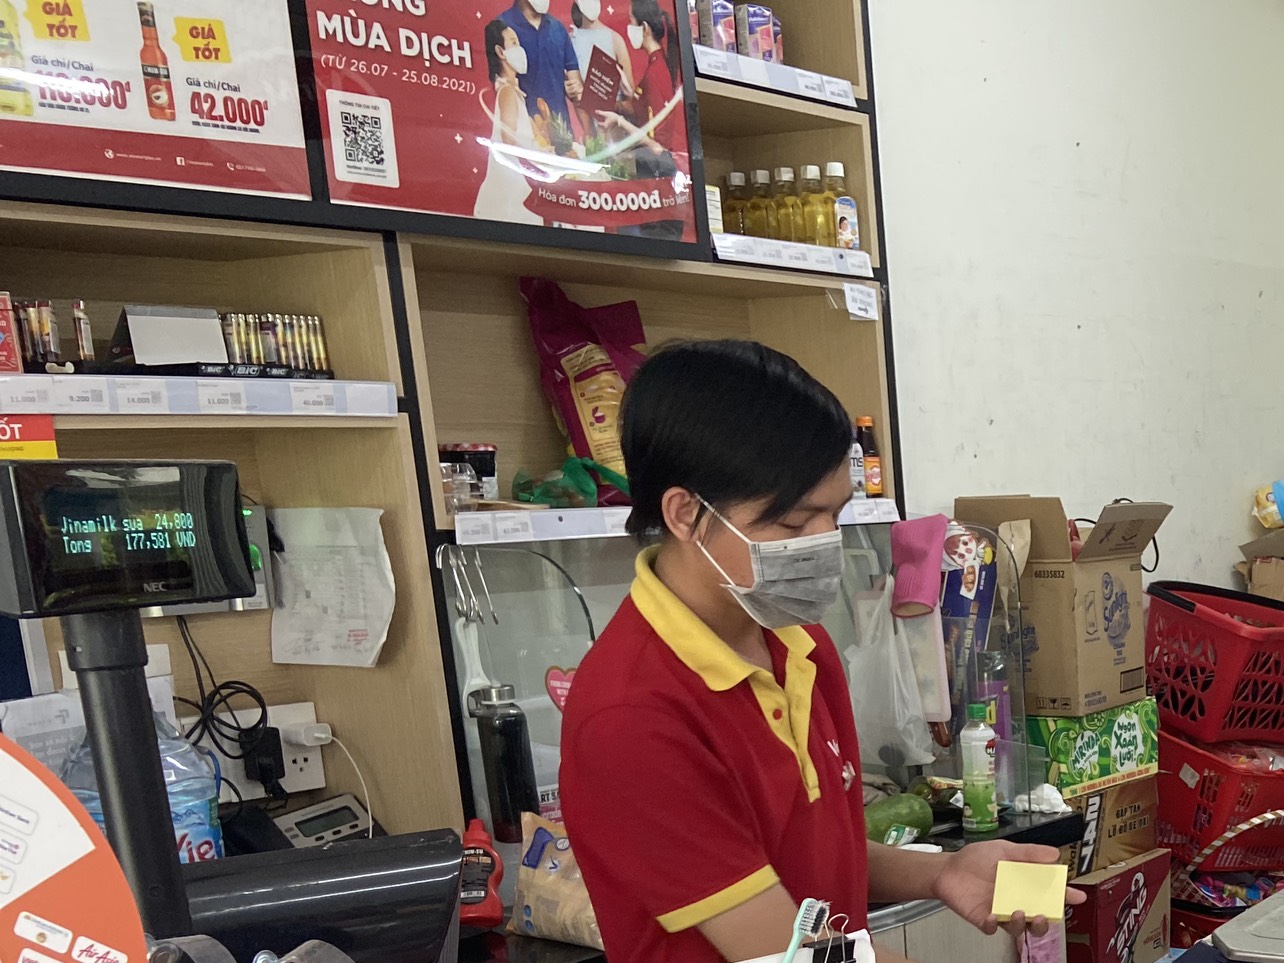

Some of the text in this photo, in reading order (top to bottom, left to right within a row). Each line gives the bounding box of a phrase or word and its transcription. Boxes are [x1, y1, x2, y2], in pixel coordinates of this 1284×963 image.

[46, 22, 77, 38] TỐT
[189, 24, 217, 40] GIÁ
[317, 10, 473, 69] MÙA DỊCH
[193, 41, 221, 60] TỐT
[320, 54, 476, 95] (TỪ 26.07 25.08.2021)
[538, 187, 557, 203] Hóa
[558, 193, 577, 208] đơn
[579, 189, 662, 212] 300.000đ
[236, 365, 257, 377] BIC
[126, 532, 196, 550] 177,581 VND
[143, 582, 167, 592] NEC
